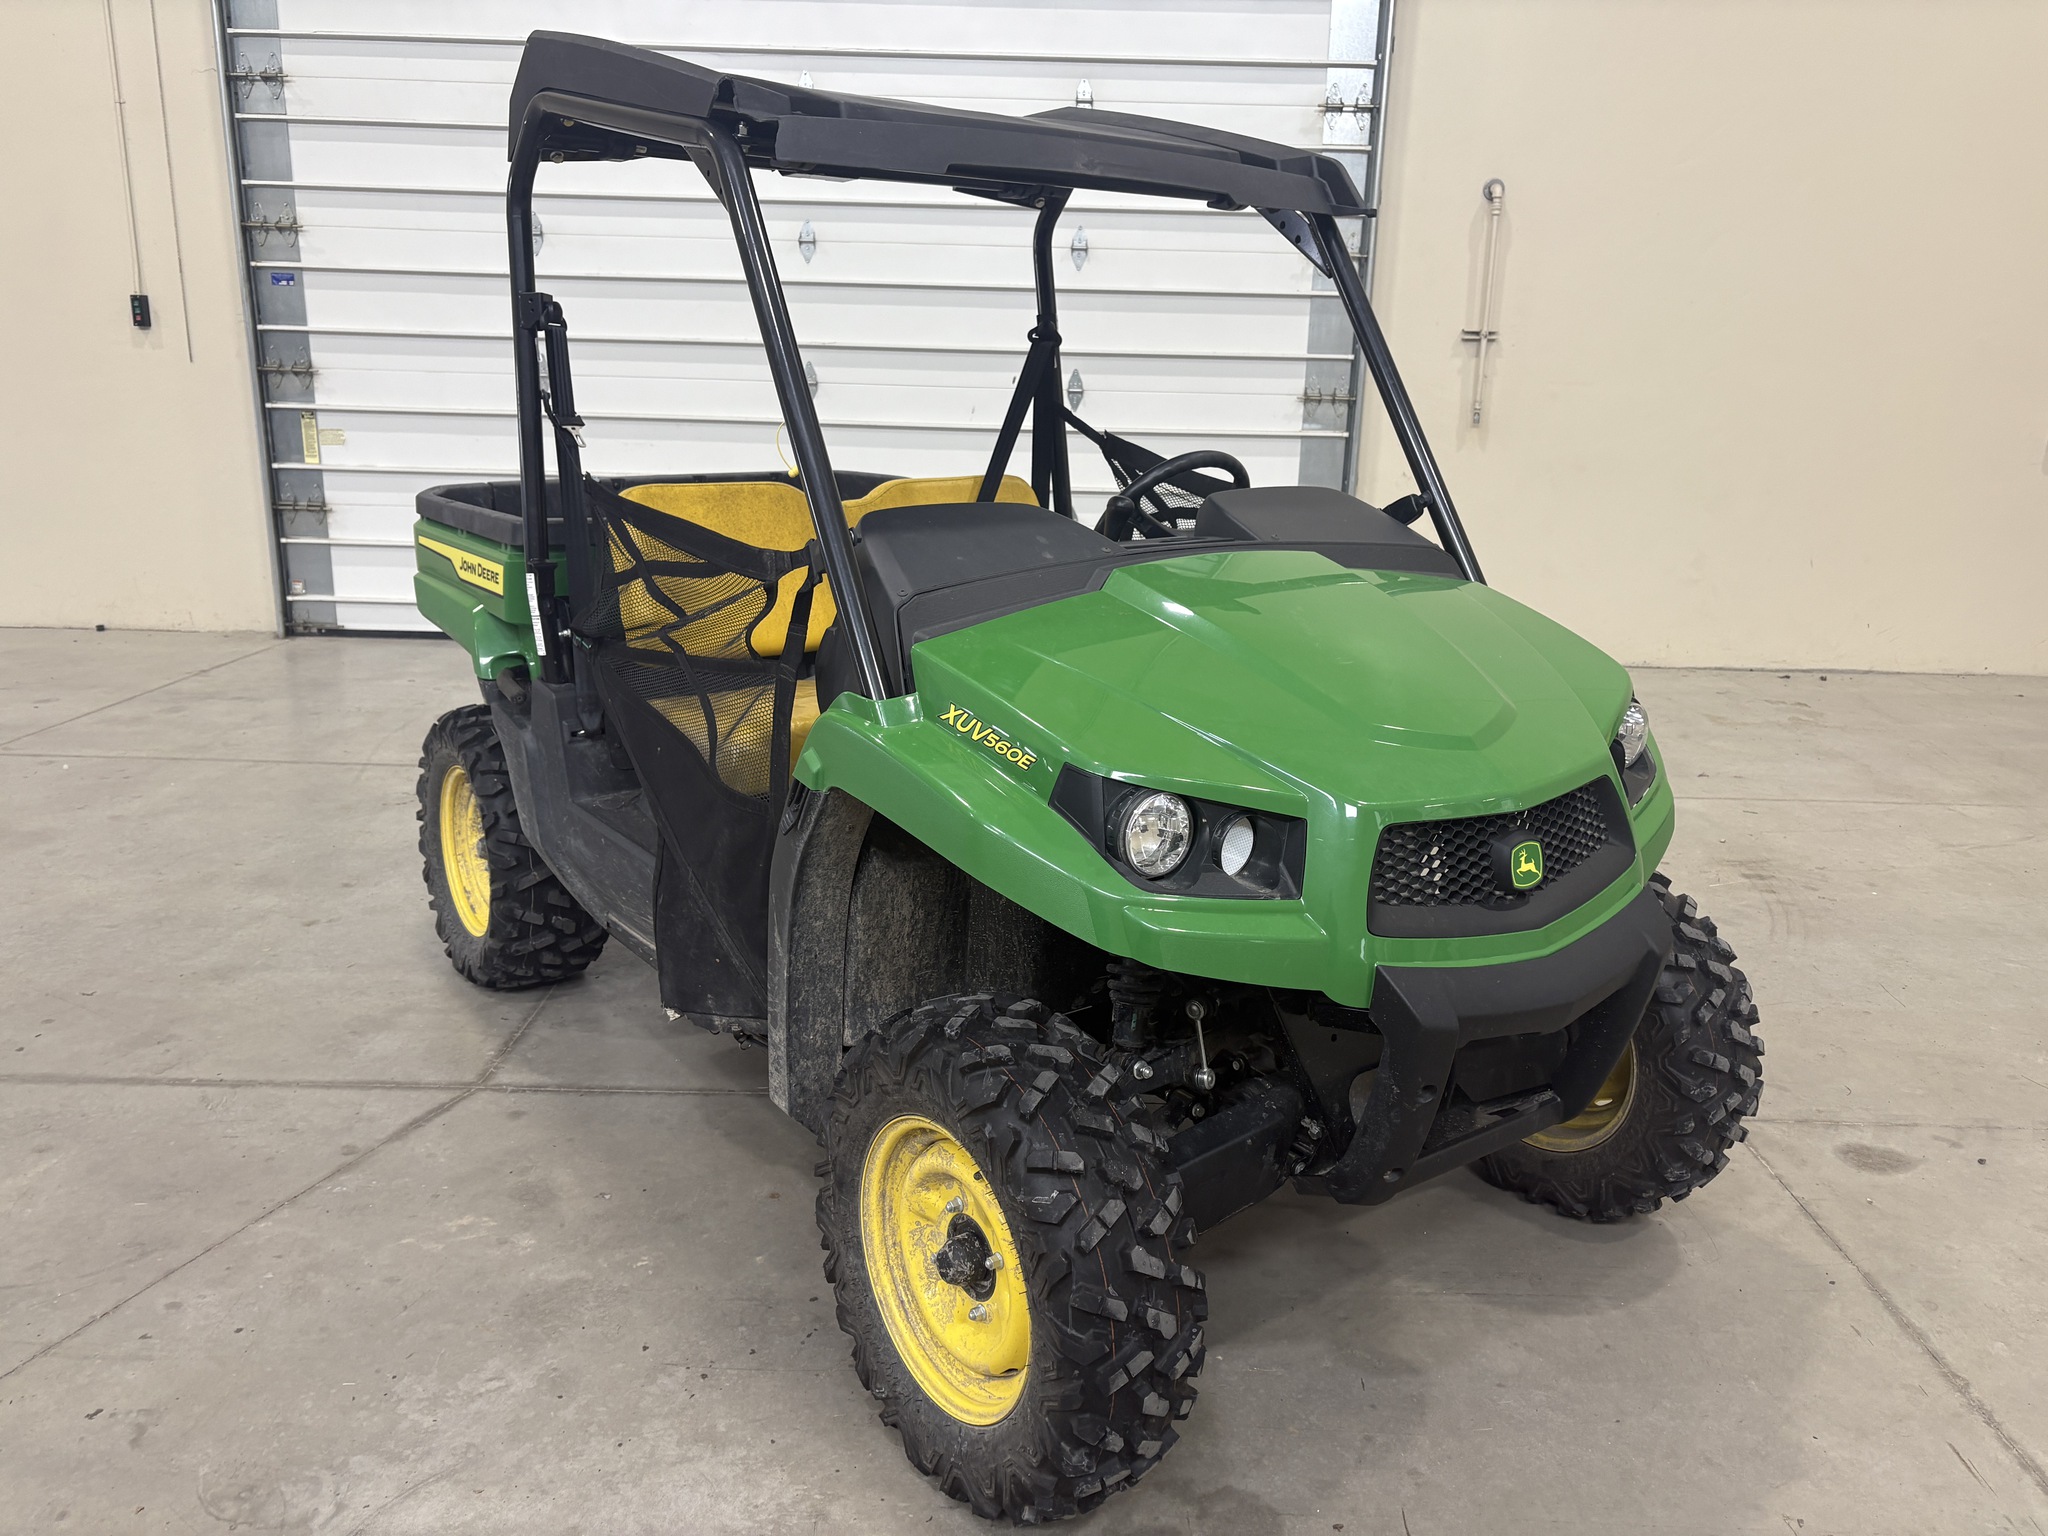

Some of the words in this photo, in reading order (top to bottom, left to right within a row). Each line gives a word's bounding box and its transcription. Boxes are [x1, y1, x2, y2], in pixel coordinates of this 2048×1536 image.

[460, 556, 476, 576] JOHN
[477, 562, 499, 585] DEERE
[938, 702, 1038, 771] XUV560E
